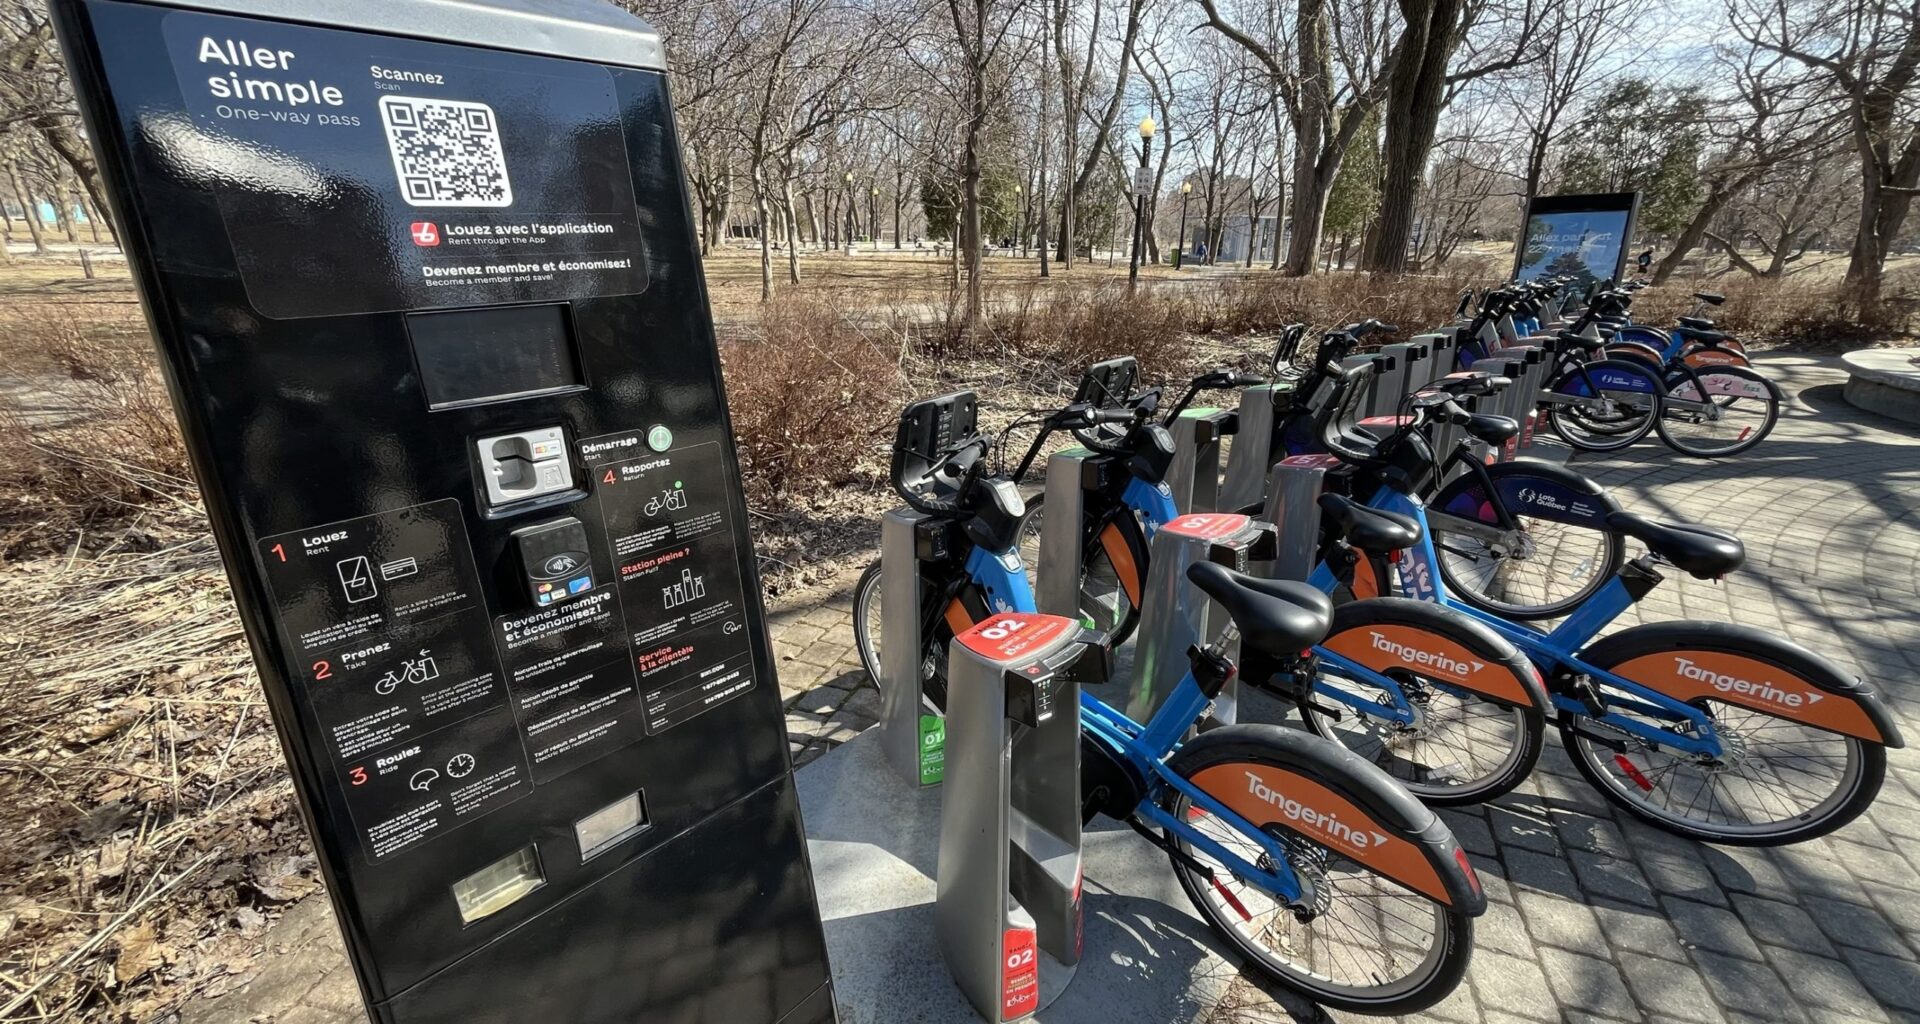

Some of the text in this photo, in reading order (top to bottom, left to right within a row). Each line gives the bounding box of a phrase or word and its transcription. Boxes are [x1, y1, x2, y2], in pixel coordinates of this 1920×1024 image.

[199, 36, 295, 70] Aller
[370, 66, 444, 84] Scannez
[208, 72, 344, 106] simple
[374, 82, 400, 90] Scan
[216, 105, 360, 126] One-way pass
[445, 222, 613, 235] Louez avec l'application
[473, 237, 510, 245] through
[529, 236, 546, 244] App
[422, 266, 482, 277] Devenez
[485, 263, 540, 274] membre
[542, 262, 556, 271] et
[425, 279, 465, 287] Become
[474, 276, 512, 284] member
[582, 437, 638, 454] Démarrage
[584, 453, 601, 461] Start
[621, 459, 670, 475] Rapportez
[603, 470, 616, 484] 4
[623, 473, 644, 481] Return
[1537, 498, 1567, 512] Québec
[1539, 493, 1555, 502] Loto
[1182, 518, 1210, 528] 02
[302, 531, 348, 547] Louez
[272, 544, 286, 562] 1
[306, 546, 329, 556] Rent
[621, 559, 656, 575] Station
[657, 551, 683, 565] pleine
[623, 571, 645, 581] Station
[503, 592, 611, 631] Devenez membre
[505, 631, 521, 642] et
[507, 635, 539, 649] Become
[546, 623, 577, 636] member
[579, 617, 592, 626] and
[982, 620, 1026, 640] 02
[341, 642, 391, 663] Prenez
[639, 647, 672, 663] Service
[658, 646, 694, 664] clientèle
[1370, 631, 1469, 674] Tangerine
[312, 661, 332, 680] 2
[345, 660, 366, 670] Take
[525, 665, 555, 678] unlocking
[642, 655, 690, 677] Customer Service
[1674, 657, 1802, 707] Tangerine
[376, 746, 421, 768] Roulez
[349, 766, 368, 786] 3
[379, 765, 398, 775] Ride
[1245, 771, 1368, 848] Tangerine
[1008, 949, 1032, 968] 02
